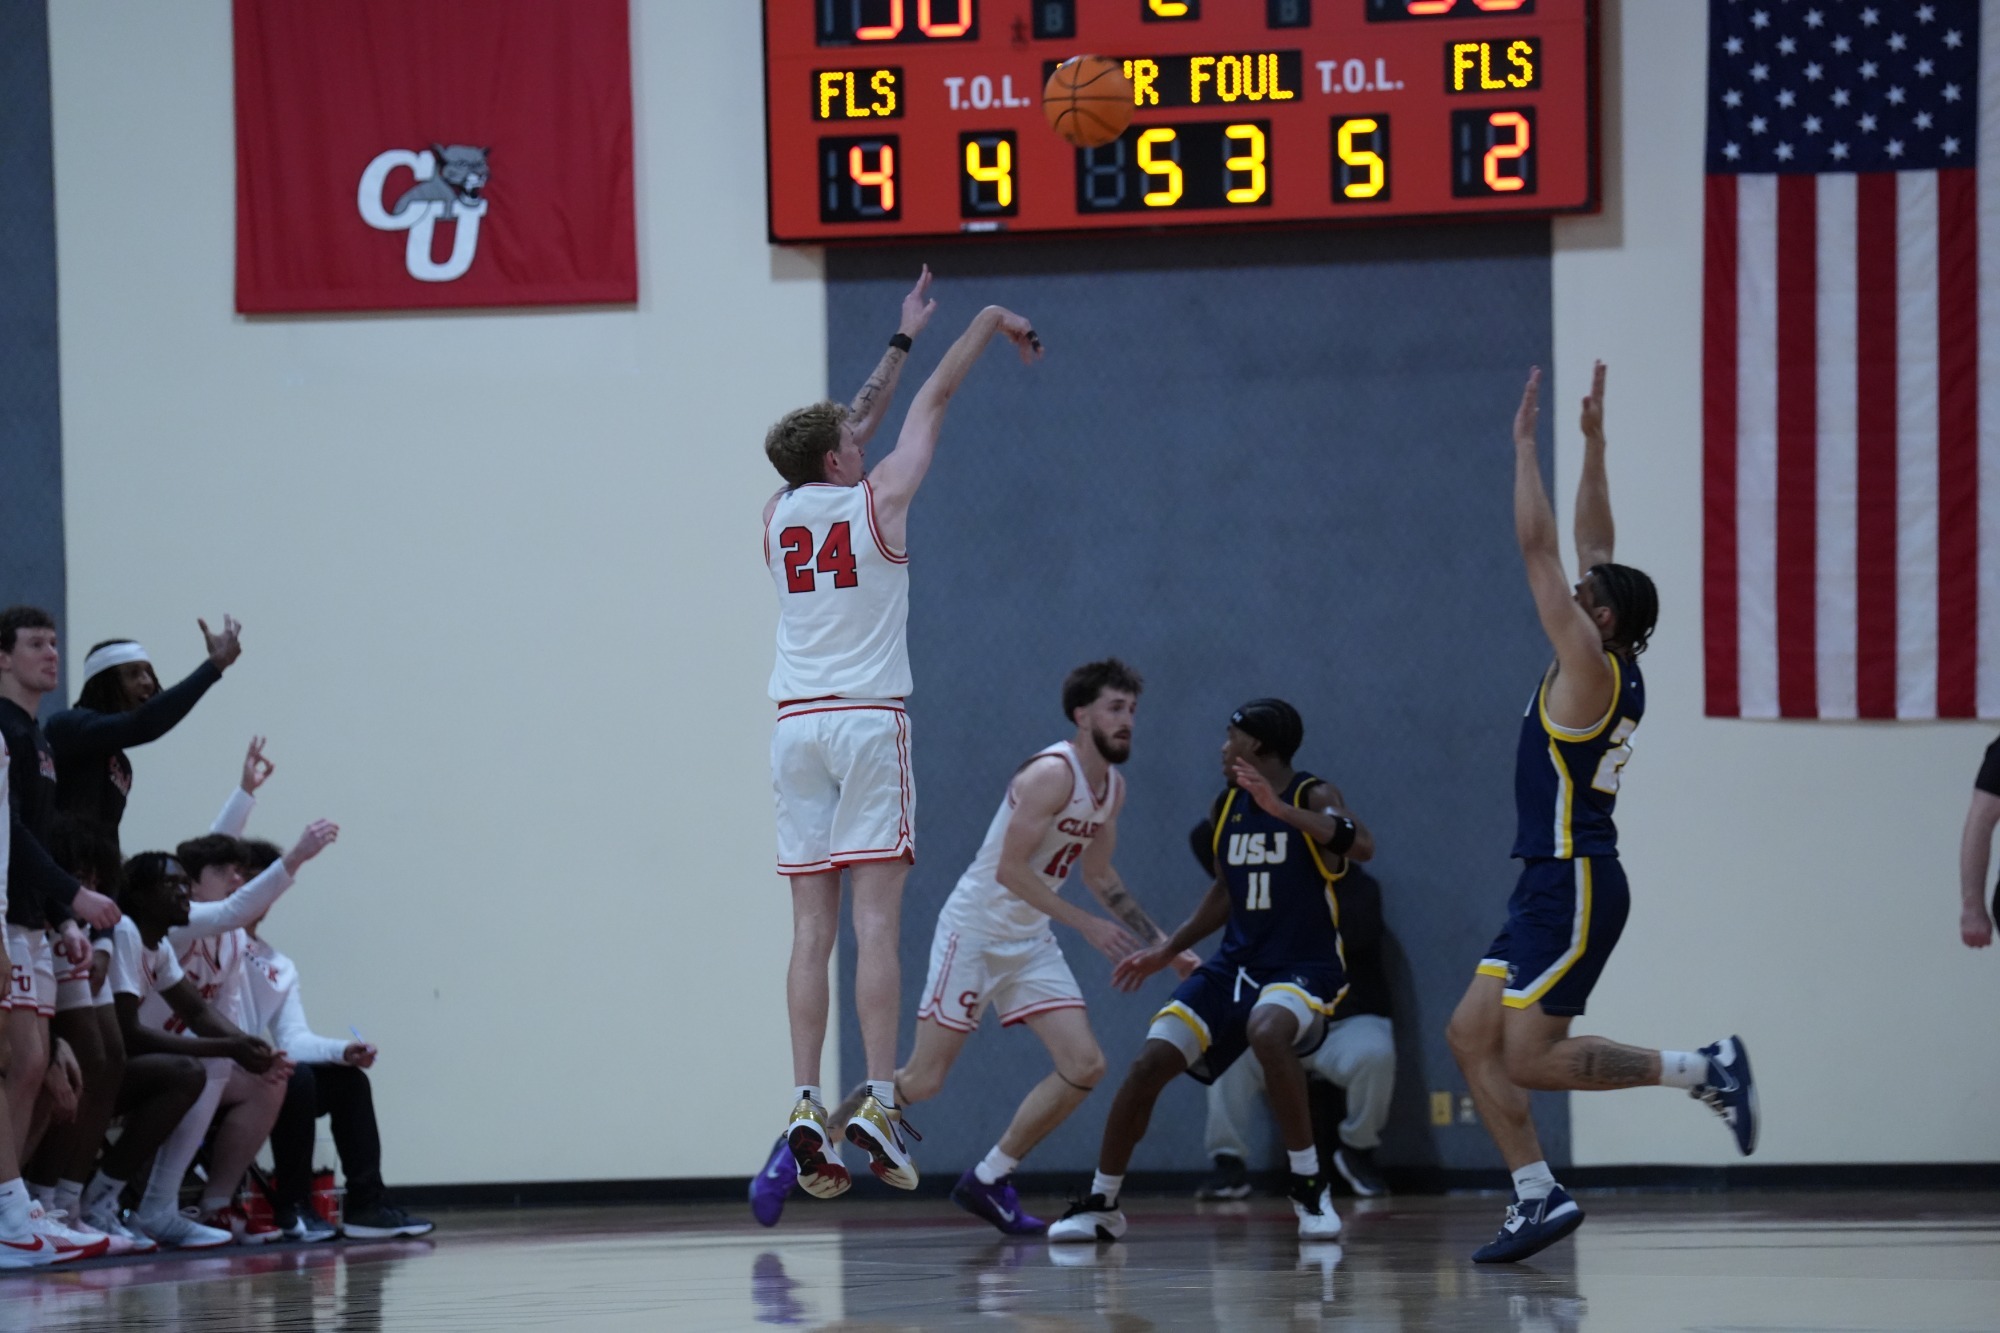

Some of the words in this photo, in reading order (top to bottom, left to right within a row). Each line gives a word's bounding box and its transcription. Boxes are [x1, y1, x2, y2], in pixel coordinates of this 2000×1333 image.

[1190, 53, 1294, 103] FOUL
[1316, 58, 1404, 94] T.O.L.
[1453, 41, 1533, 91] FLS
[818, 70, 896, 118] FLS
[944, 75, 1031, 111] T.O.L.
[965, 140, 1012, 207] 4
[1337, 118, 1385, 198] 5
[1483, 111, 1530, 192] 2
[849, 144, 895, 212] 4
[357, 148, 488, 282] CU
[779, 520, 859, 594] 24
[1227, 831, 1288, 866] USJ
[1246, 871, 1271, 910] 11
